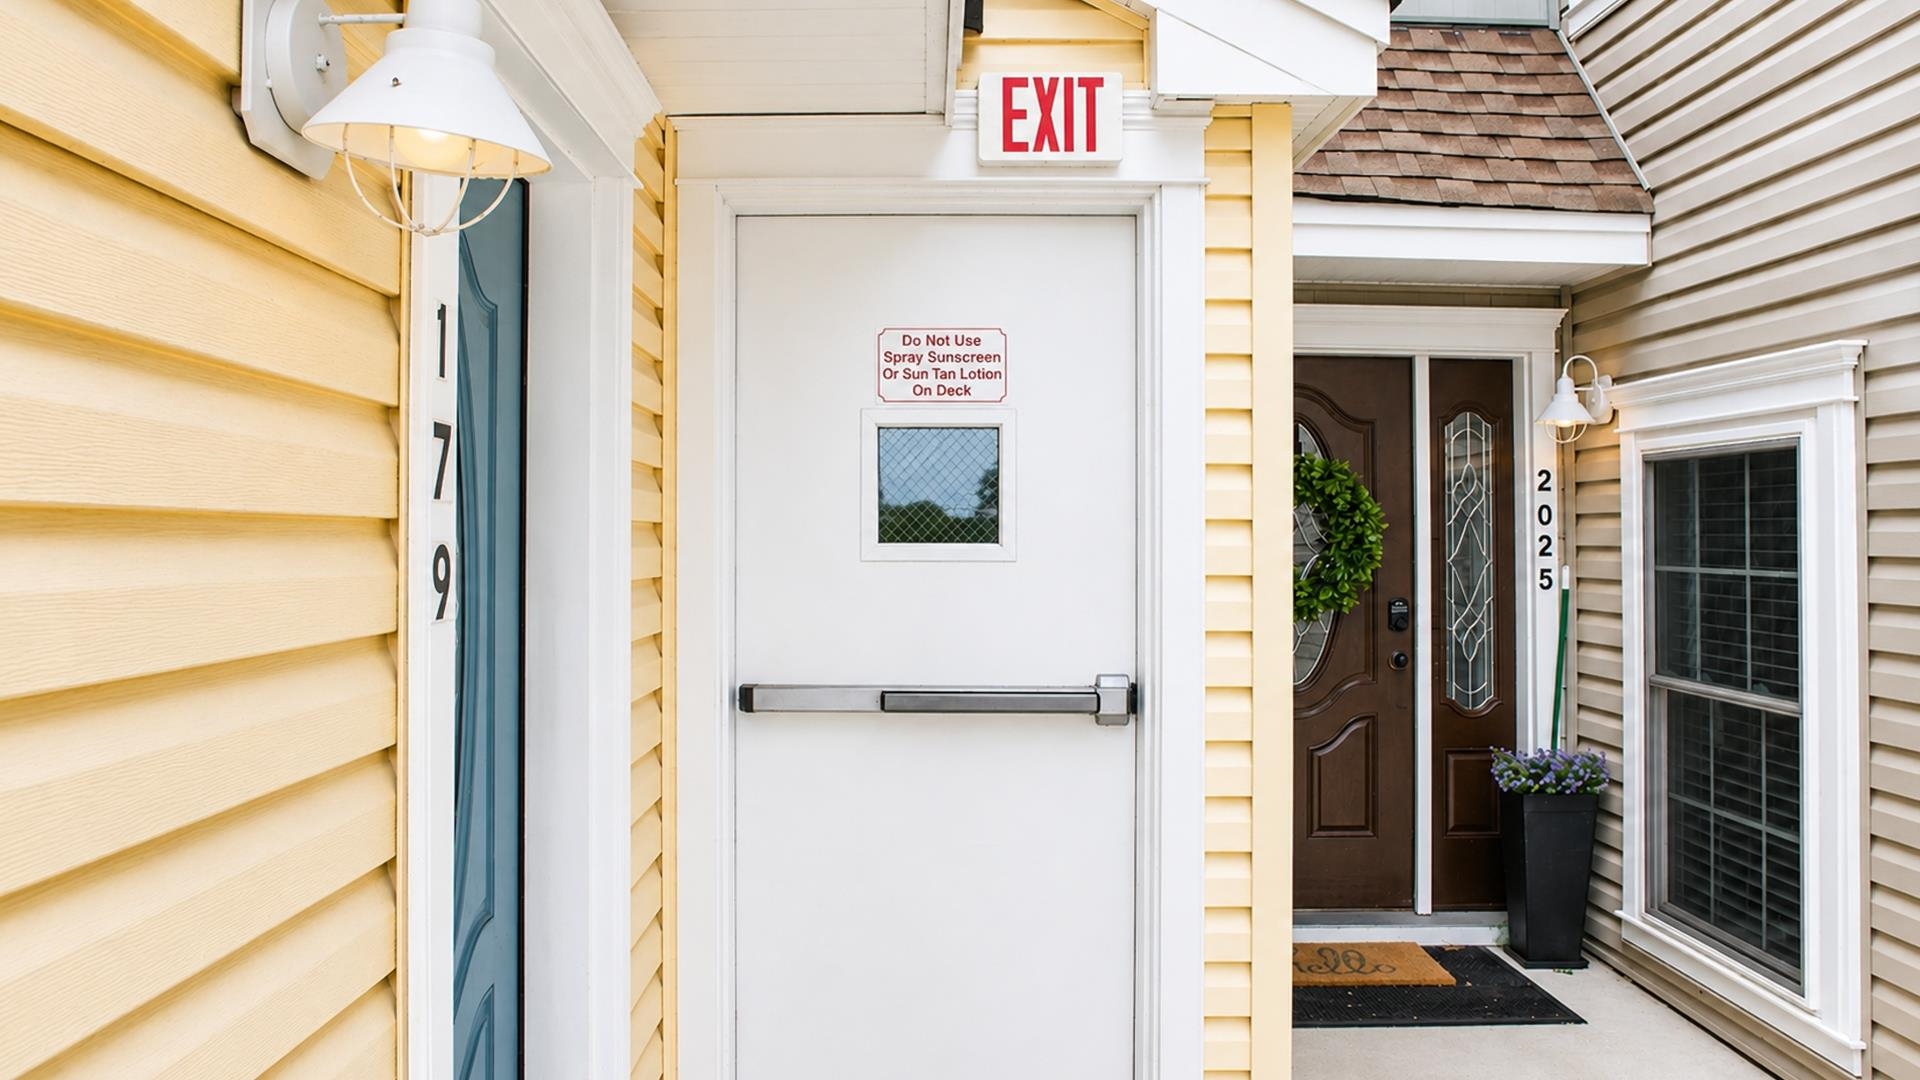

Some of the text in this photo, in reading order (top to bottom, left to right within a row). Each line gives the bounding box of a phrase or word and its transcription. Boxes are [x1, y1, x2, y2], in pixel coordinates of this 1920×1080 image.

[1002, 76, 1104, 153] EXIT
[902, 334, 982, 346] Do Not Use
[883, 350, 1001, 366] Spray Sunscreen
[882, 367, 1002, 380] Or Sun Tan Lotion
[912, 384, 971, 396] On Deck
[433, 303, 452, 621] 179
[1537, 469, 1553, 591] 2025
